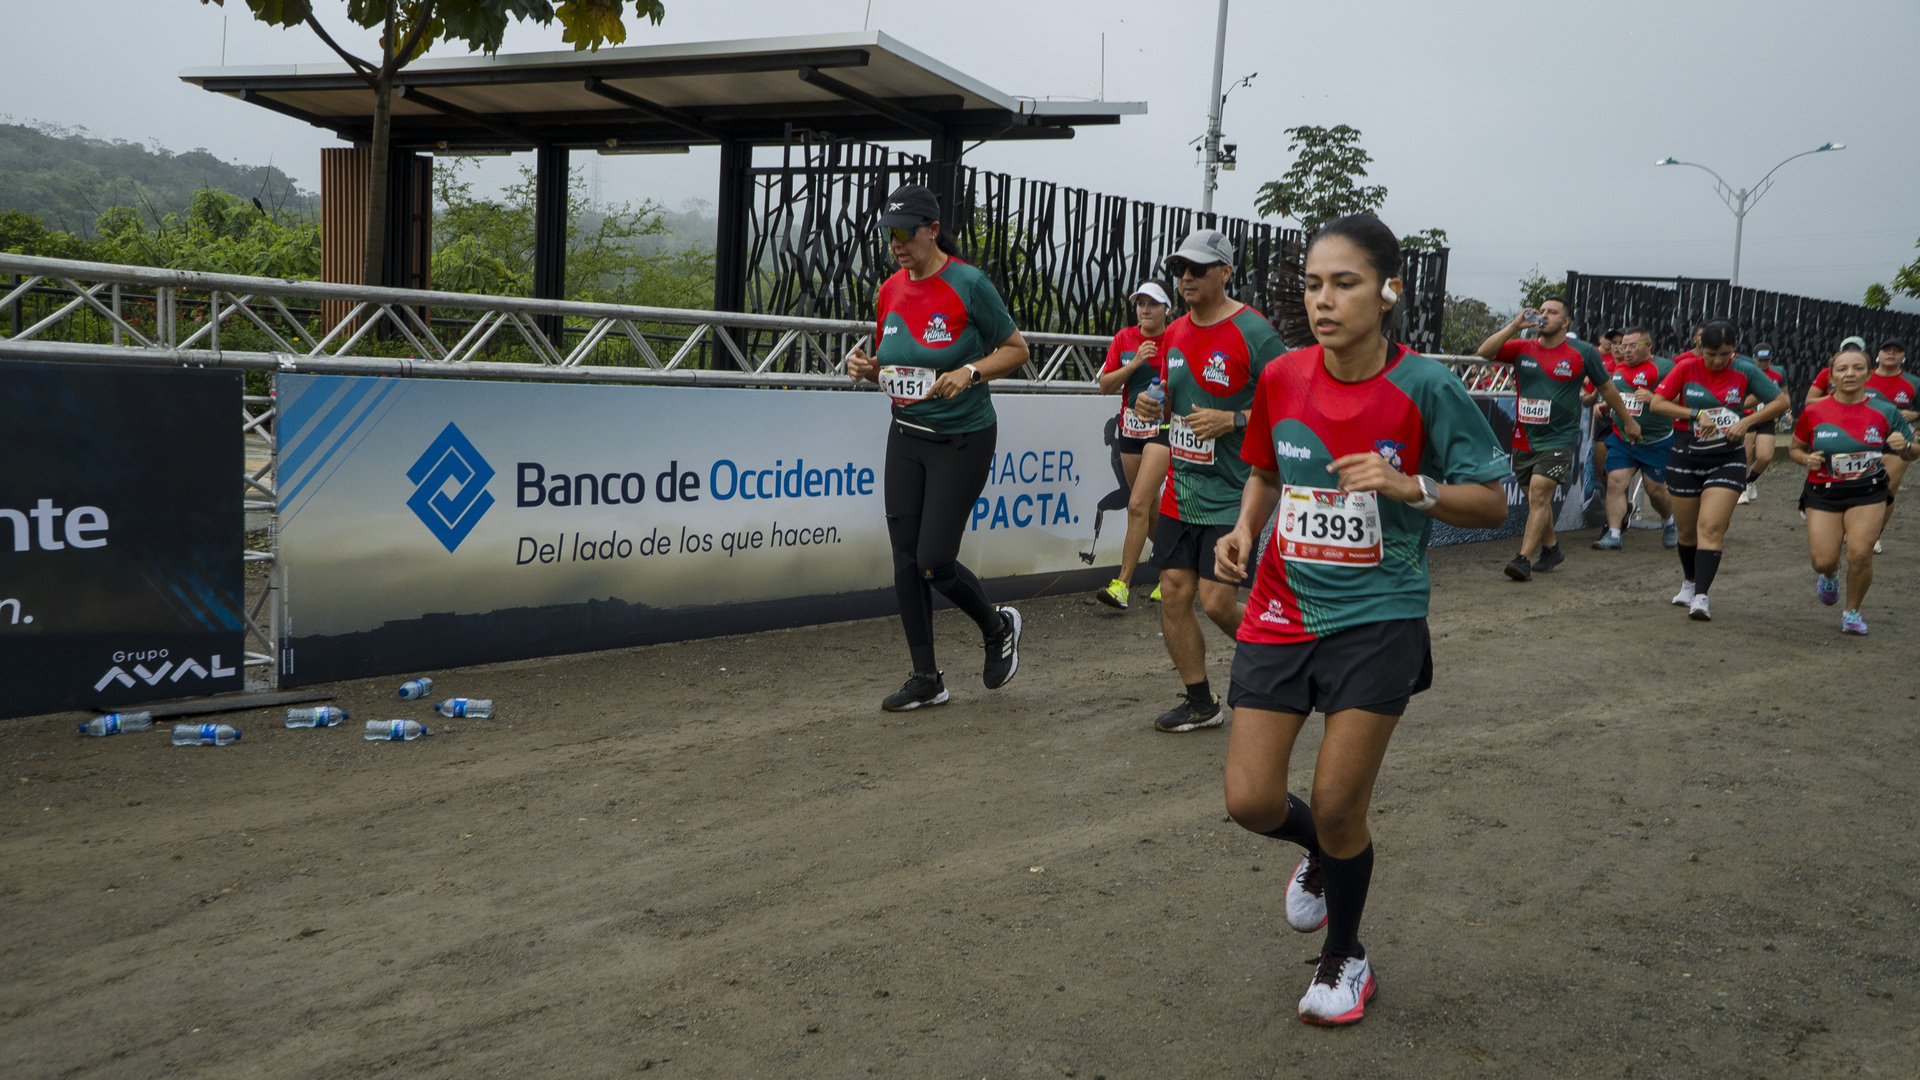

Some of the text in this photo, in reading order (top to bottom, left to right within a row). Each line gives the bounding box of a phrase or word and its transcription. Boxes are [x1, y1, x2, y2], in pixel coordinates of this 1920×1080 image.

[888, 379, 924, 396] 1151
[1522, 406, 1544, 416] 1848
[516, 458, 875, 508] Banco de Occidente
[964, 492, 1079, 531] PACTA.
[1297, 511, 1365, 542] 1393
[516, 521, 843, 566] Del lado de los que hacen.
[93, 654, 236, 692] AVAL
[112, 648, 169, 664] Grupo
